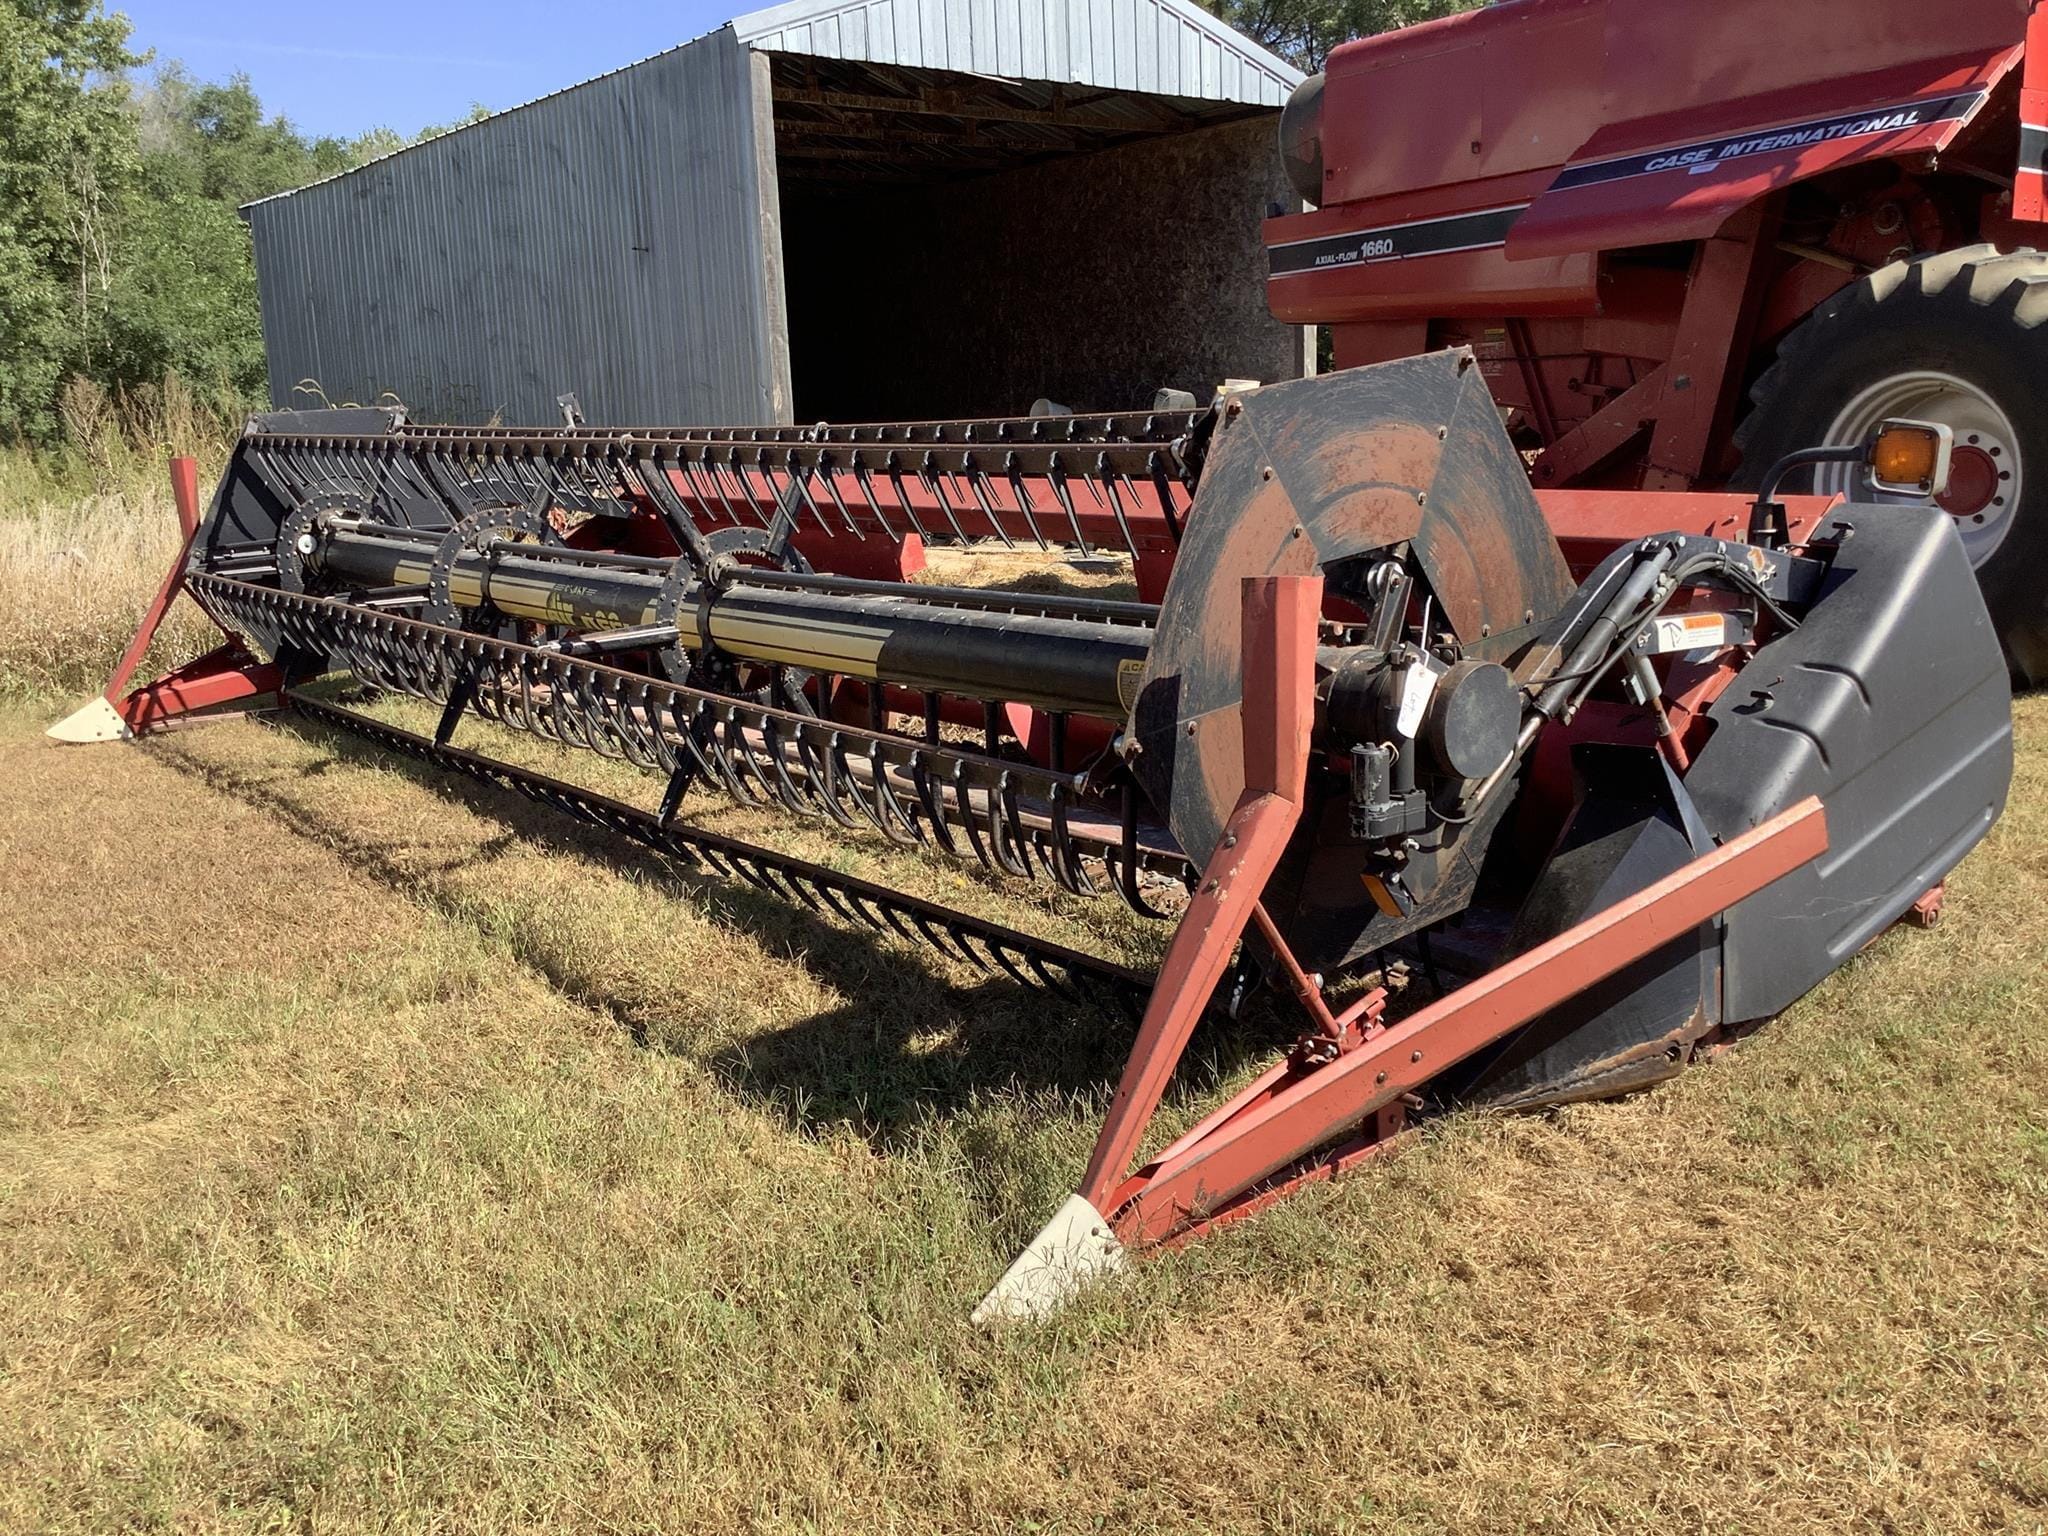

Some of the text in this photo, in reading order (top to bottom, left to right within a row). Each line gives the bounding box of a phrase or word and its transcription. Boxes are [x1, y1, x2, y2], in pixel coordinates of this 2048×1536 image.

[1644, 110, 1921, 171] CASE INTERNATIONAL
[1360, 238, 1394, 258] 1660
